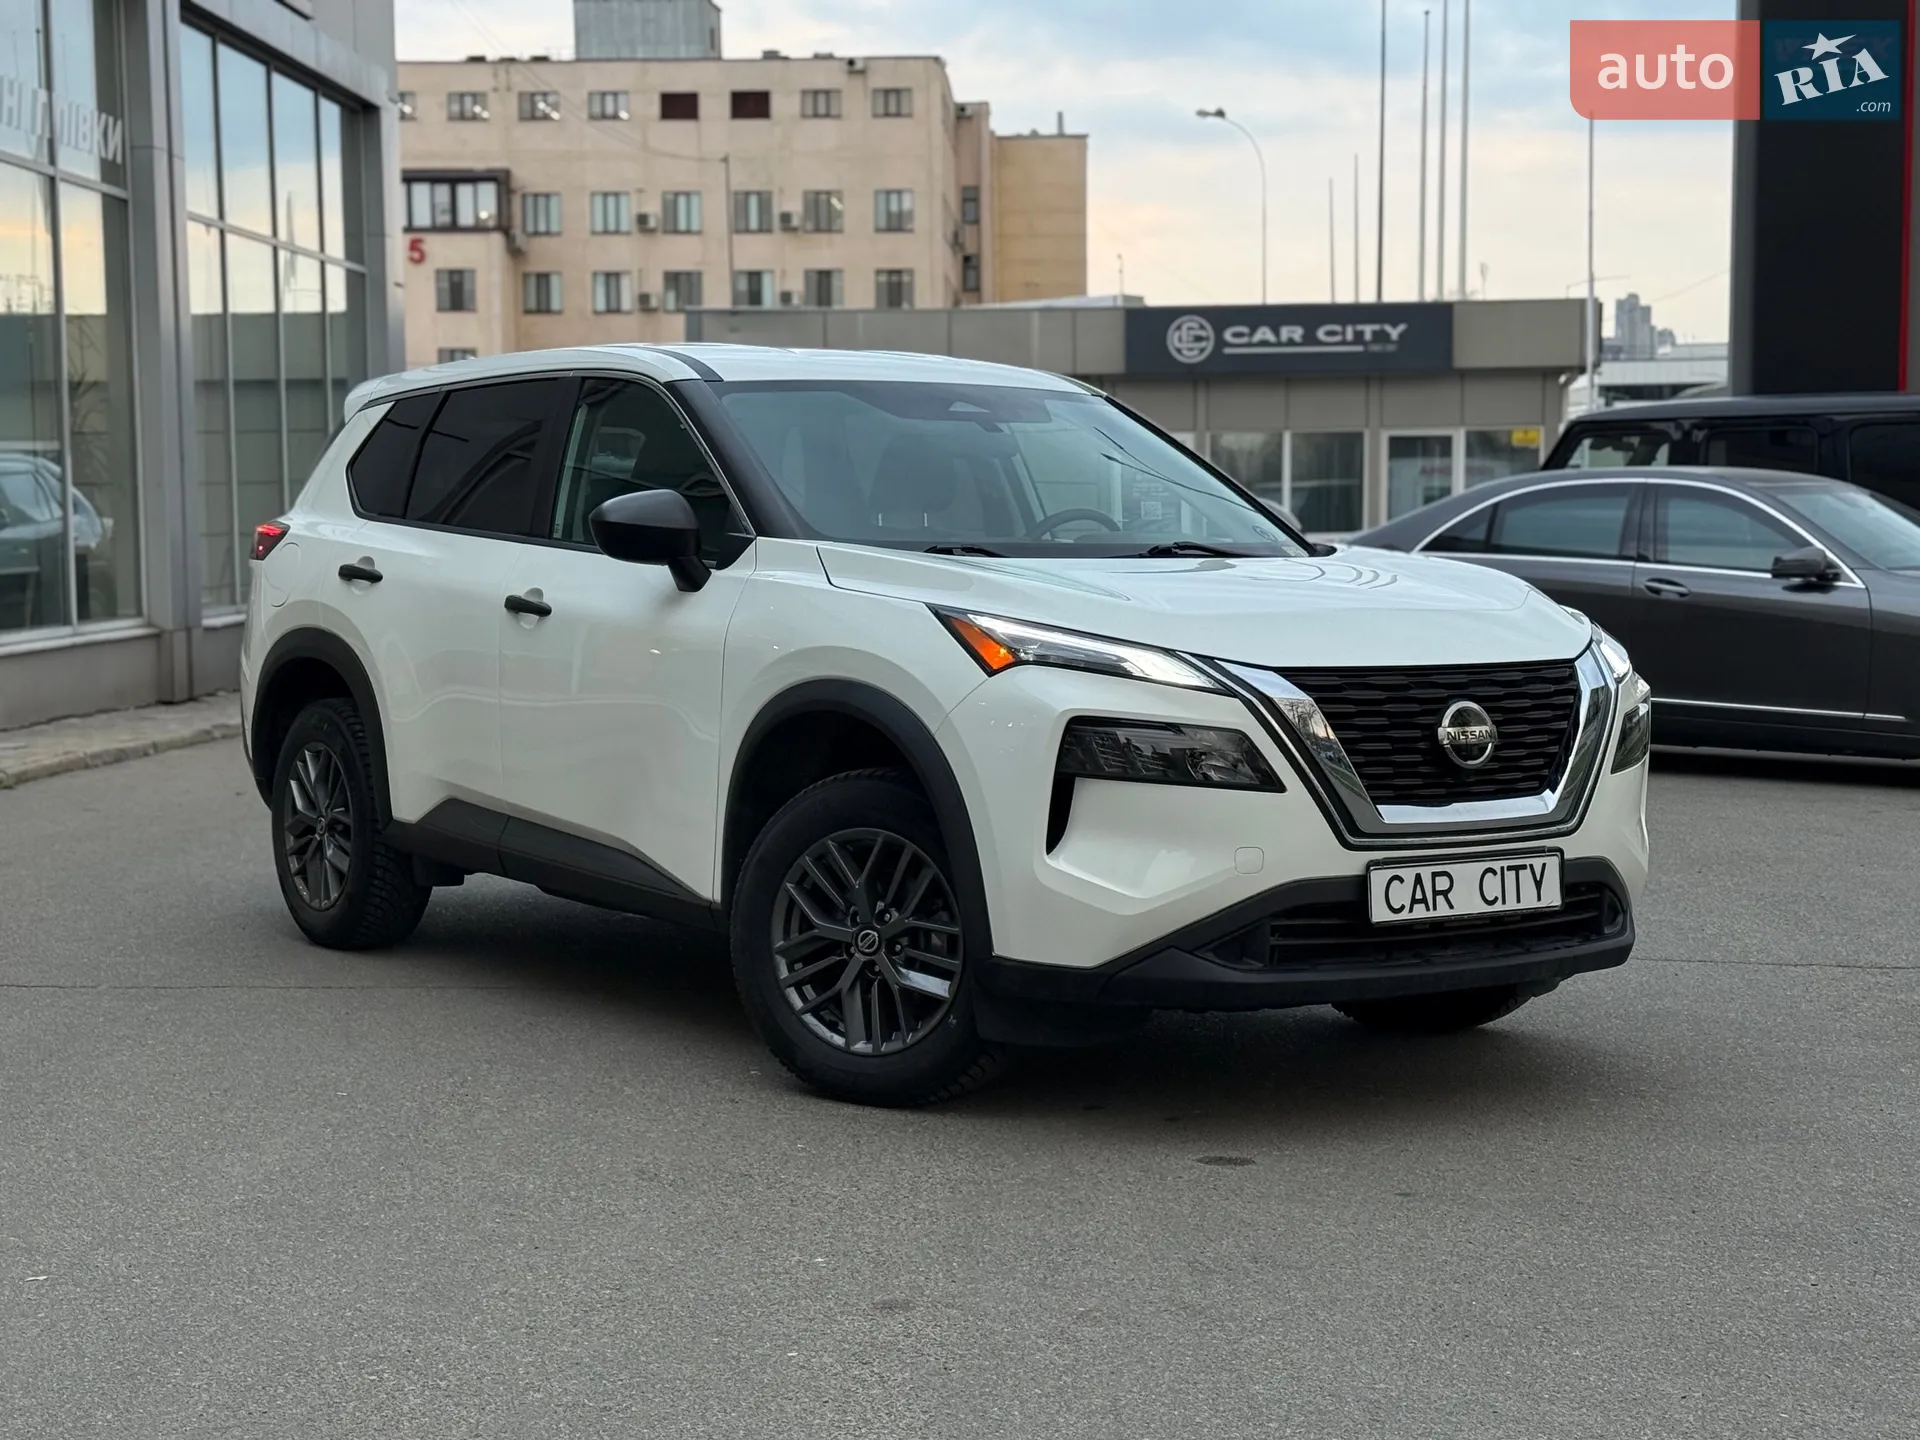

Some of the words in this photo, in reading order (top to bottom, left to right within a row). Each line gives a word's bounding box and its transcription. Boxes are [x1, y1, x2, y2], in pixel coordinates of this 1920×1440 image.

[408, 238, 427, 264] 5
[1222, 325, 1305, 344] CAR
[1315, 322, 1408, 343] CITY
[1446, 728, 1494, 742] NISSAN
[1384, 870, 1455, 915] CAR
[1478, 862, 1547, 906] CITY
